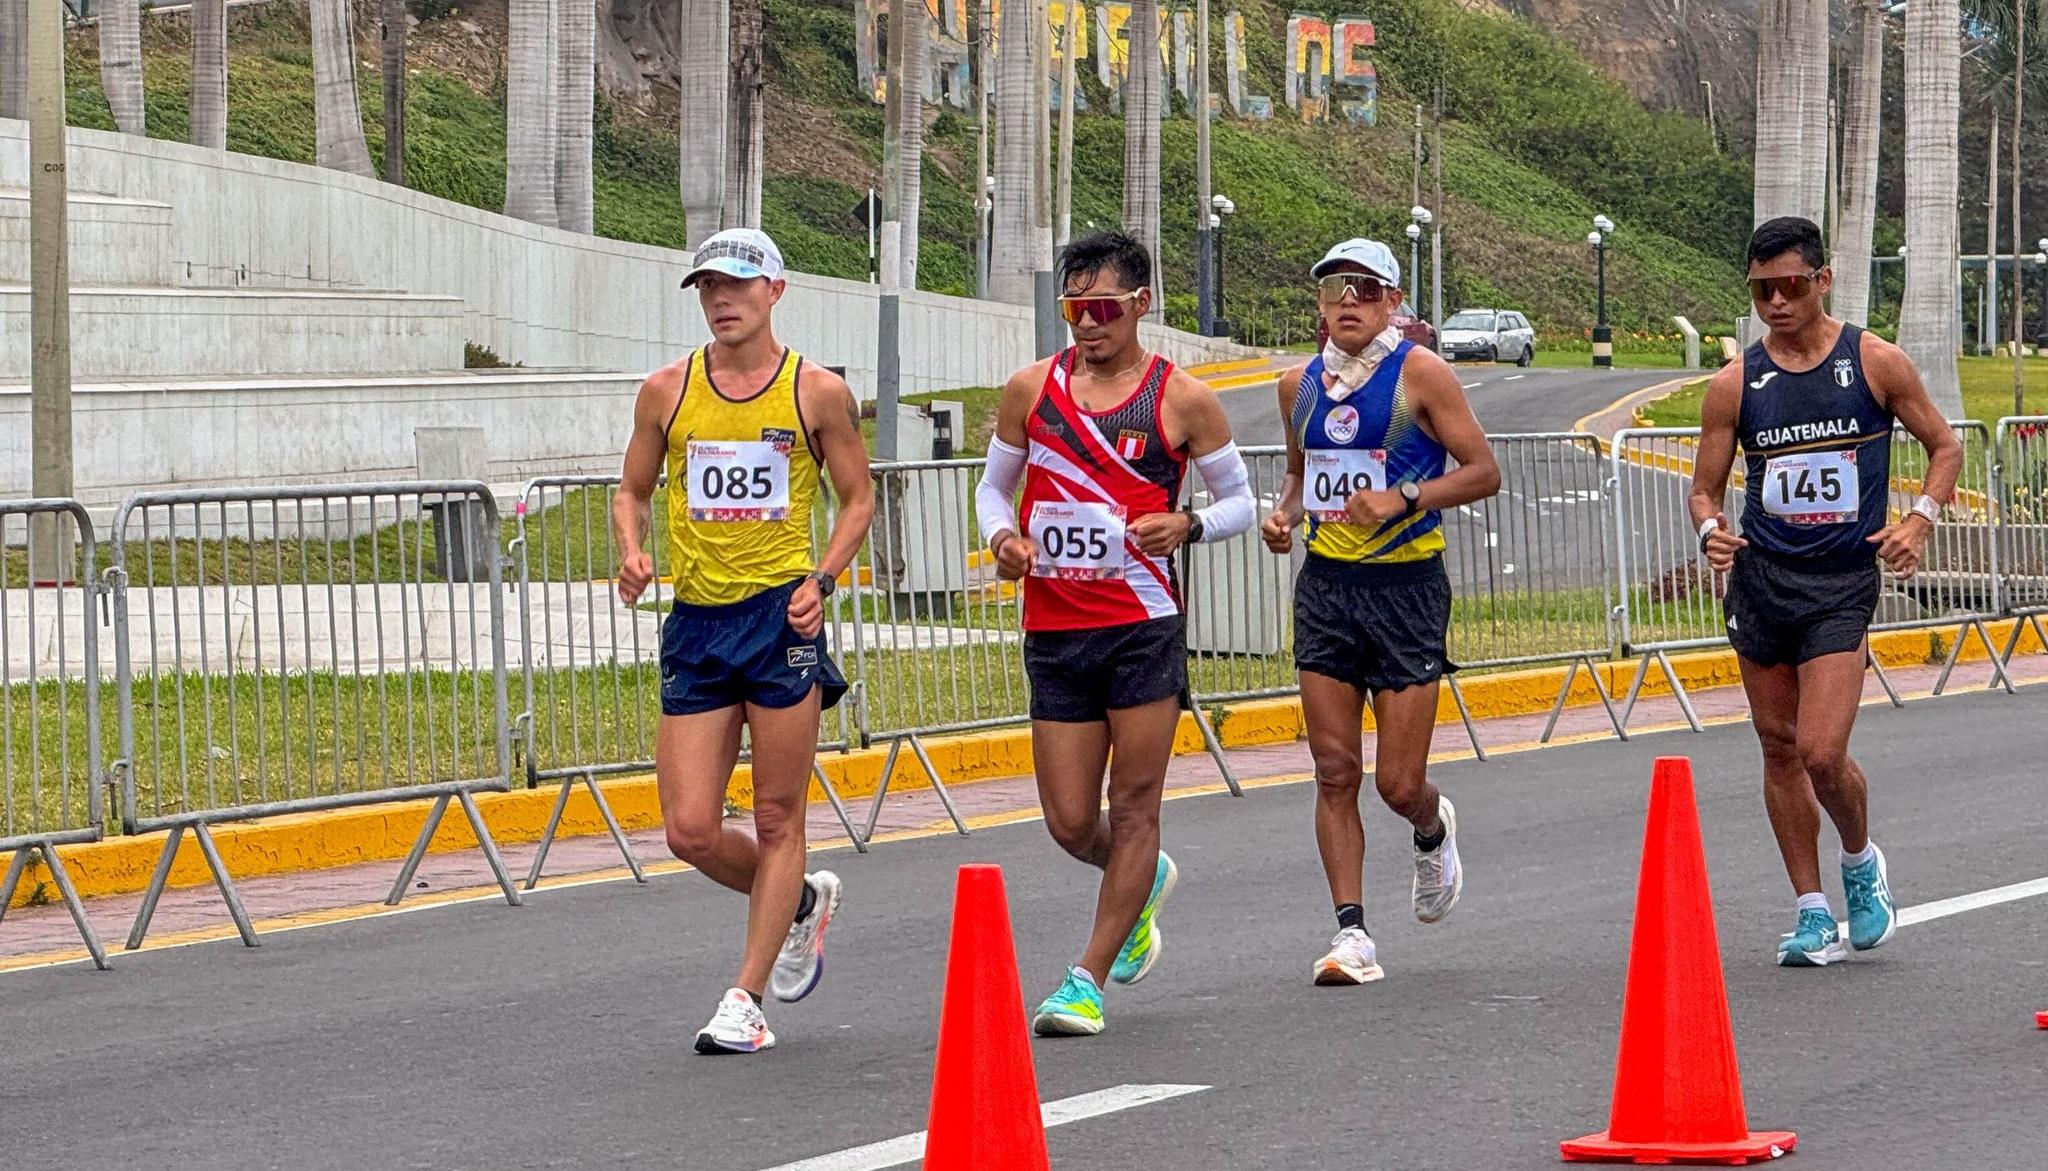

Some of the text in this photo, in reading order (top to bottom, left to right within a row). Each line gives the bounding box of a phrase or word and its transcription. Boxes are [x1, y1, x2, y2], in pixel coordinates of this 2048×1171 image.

[1756, 418, 1860, 447] GUATEMALA
[702, 465, 773, 500] 085
[1314, 471, 1372, 503] 049
[1776, 467, 1842, 504] 145
[1042, 526, 1108, 560] 055
